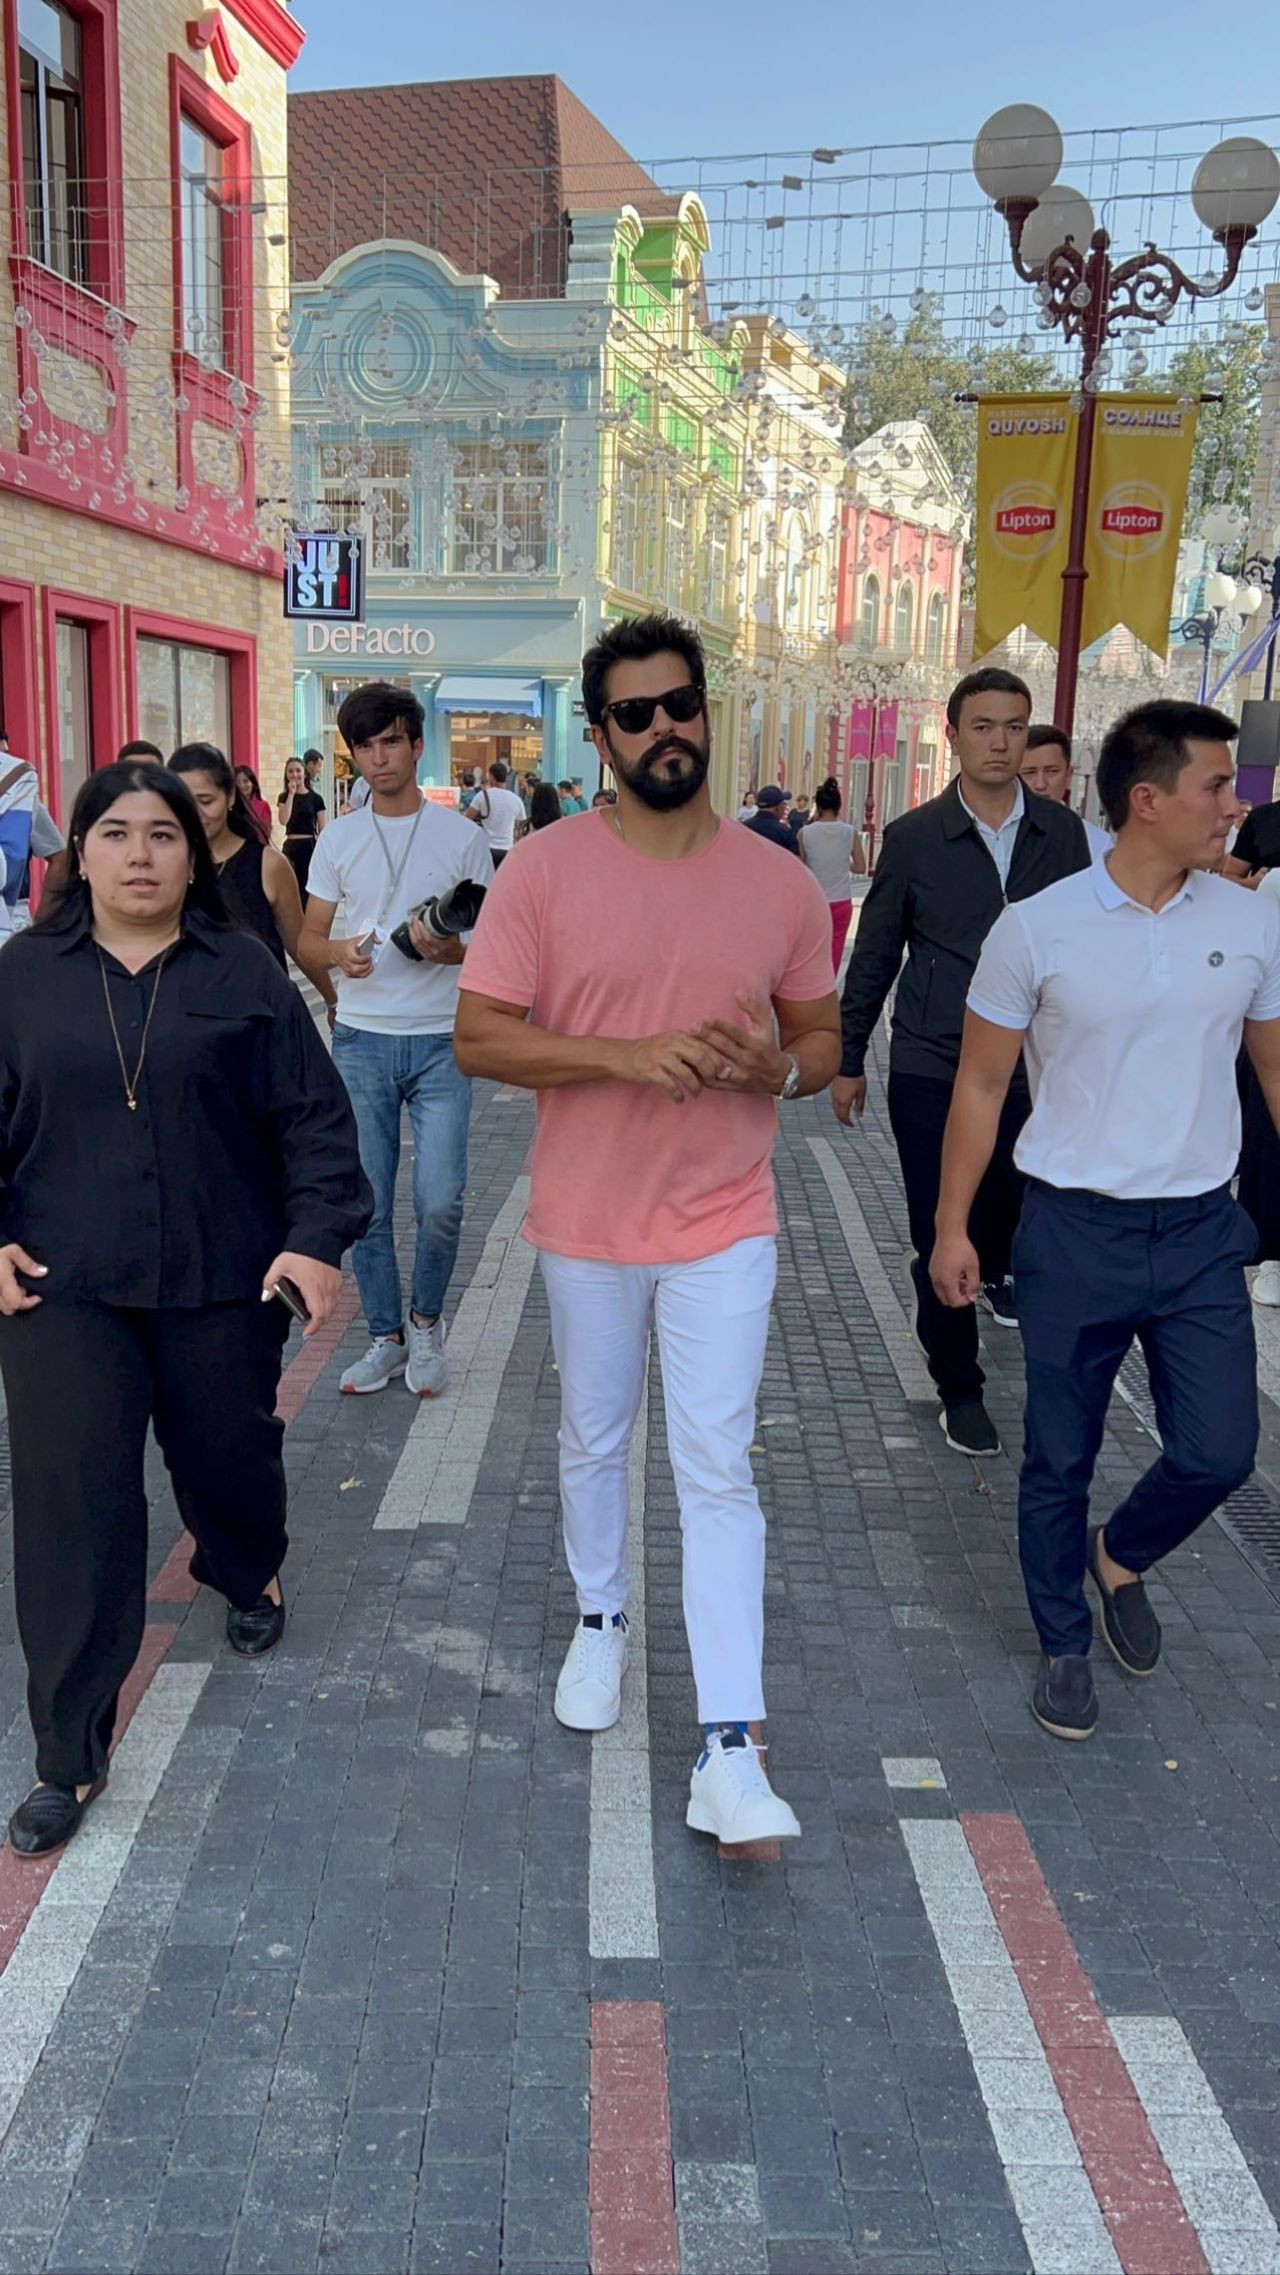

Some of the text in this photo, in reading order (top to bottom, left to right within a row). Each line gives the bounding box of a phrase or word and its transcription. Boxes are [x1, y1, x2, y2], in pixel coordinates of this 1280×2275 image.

[988, 417, 1065, 436] QUYOSH
[1104, 408, 1182, 429] СОЛНЦЕ
[1001, 512, 1051, 530] Lipton
[1107, 511, 1158, 530] Lipton
[297, 573, 348, 607] ST!
[306, 622, 436, 656] DeFacto
